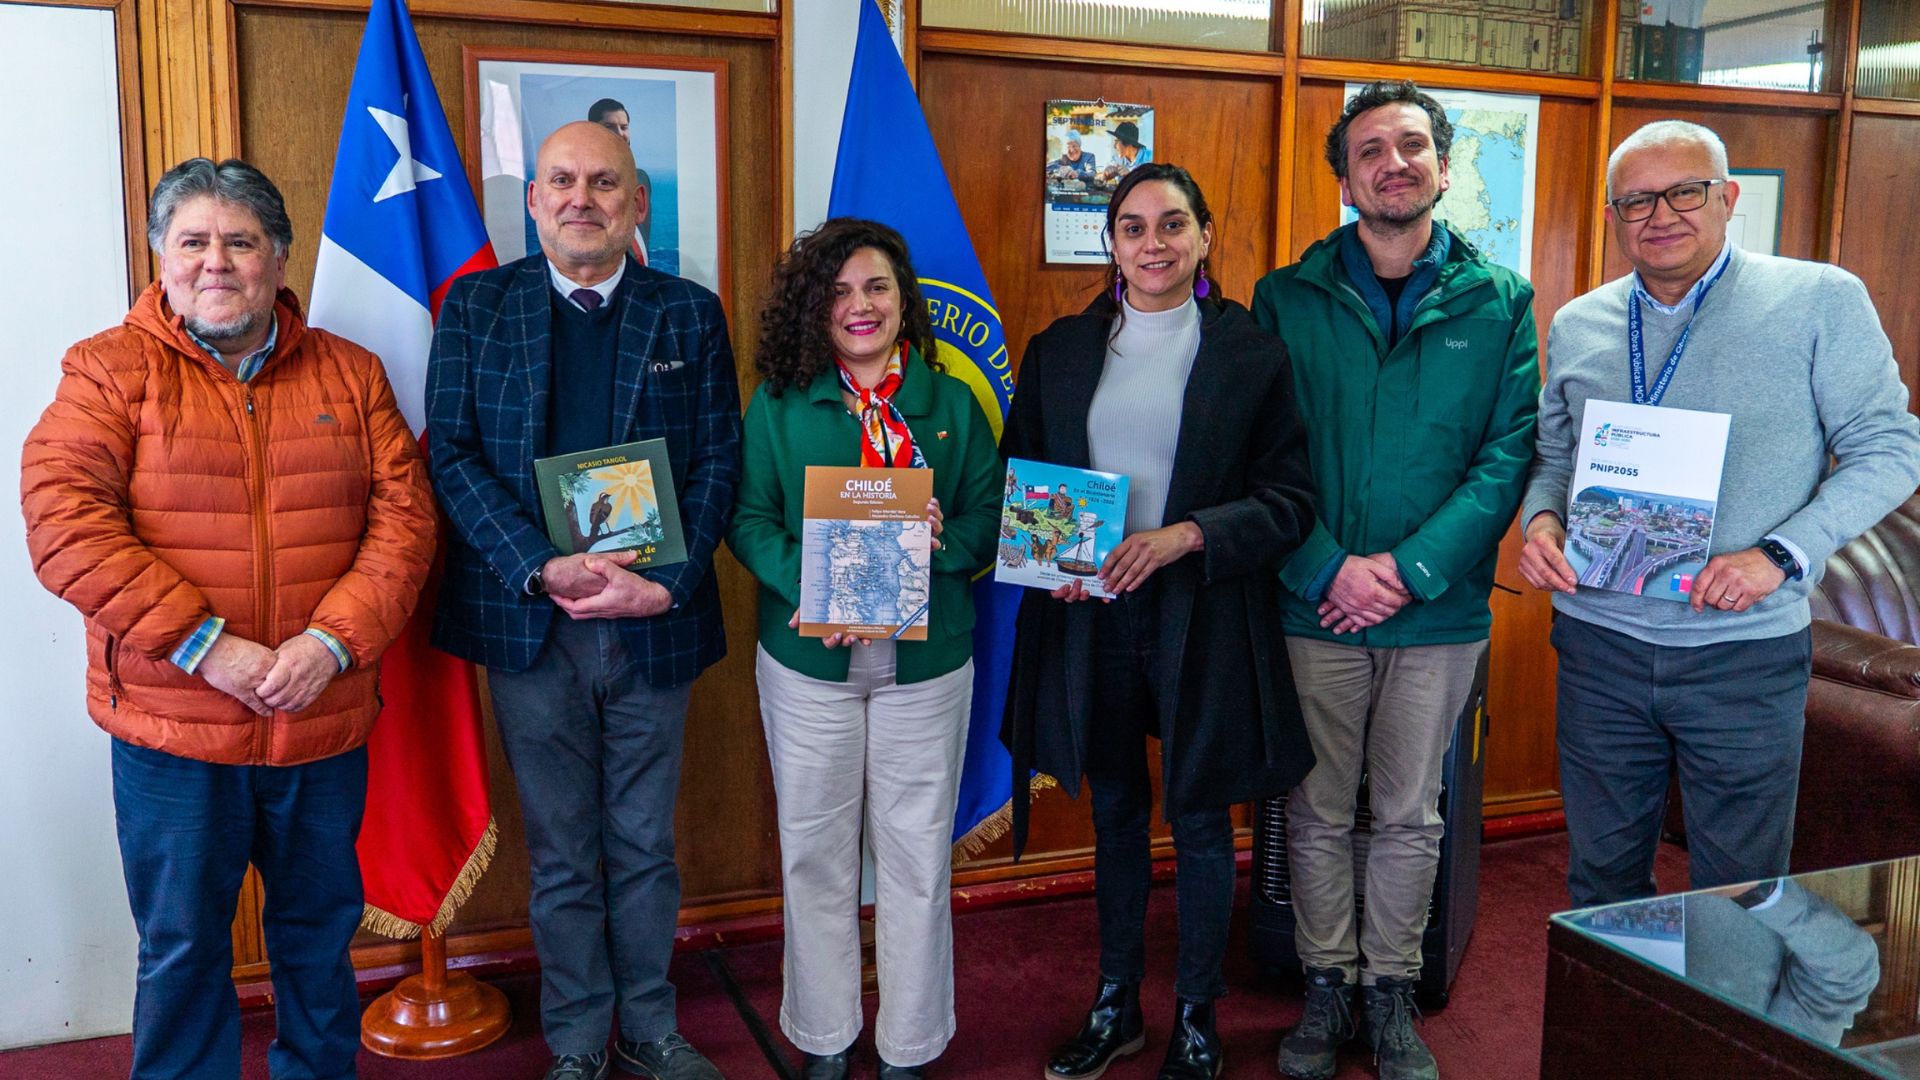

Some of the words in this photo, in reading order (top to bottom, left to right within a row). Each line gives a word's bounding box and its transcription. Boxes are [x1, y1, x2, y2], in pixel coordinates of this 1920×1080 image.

[926, 298, 990, 347] ERIO
[1630, 330, 1640, 352] Obras
[1648, 366, 1673, 406] Ministerio
[1669, 354, 1678, 367] de
[1611, 428, 1660, 438] INFRAESTRUCTURA
[576, 459, 602, 470] NICASIO
[603, 456, 628, 466] TANGOL
[1590, 462, 1639, 477] PNIP2055
[845, 478, 892, 492] CHILOÉ
[1087, 480, 1116, 493] Chiloé
[840, 491, 851, 499] EN
[852, 491, 862, 499] LA
[862, 491, 897, 500] HISTORIA
[644, 545, 656, 554] de
